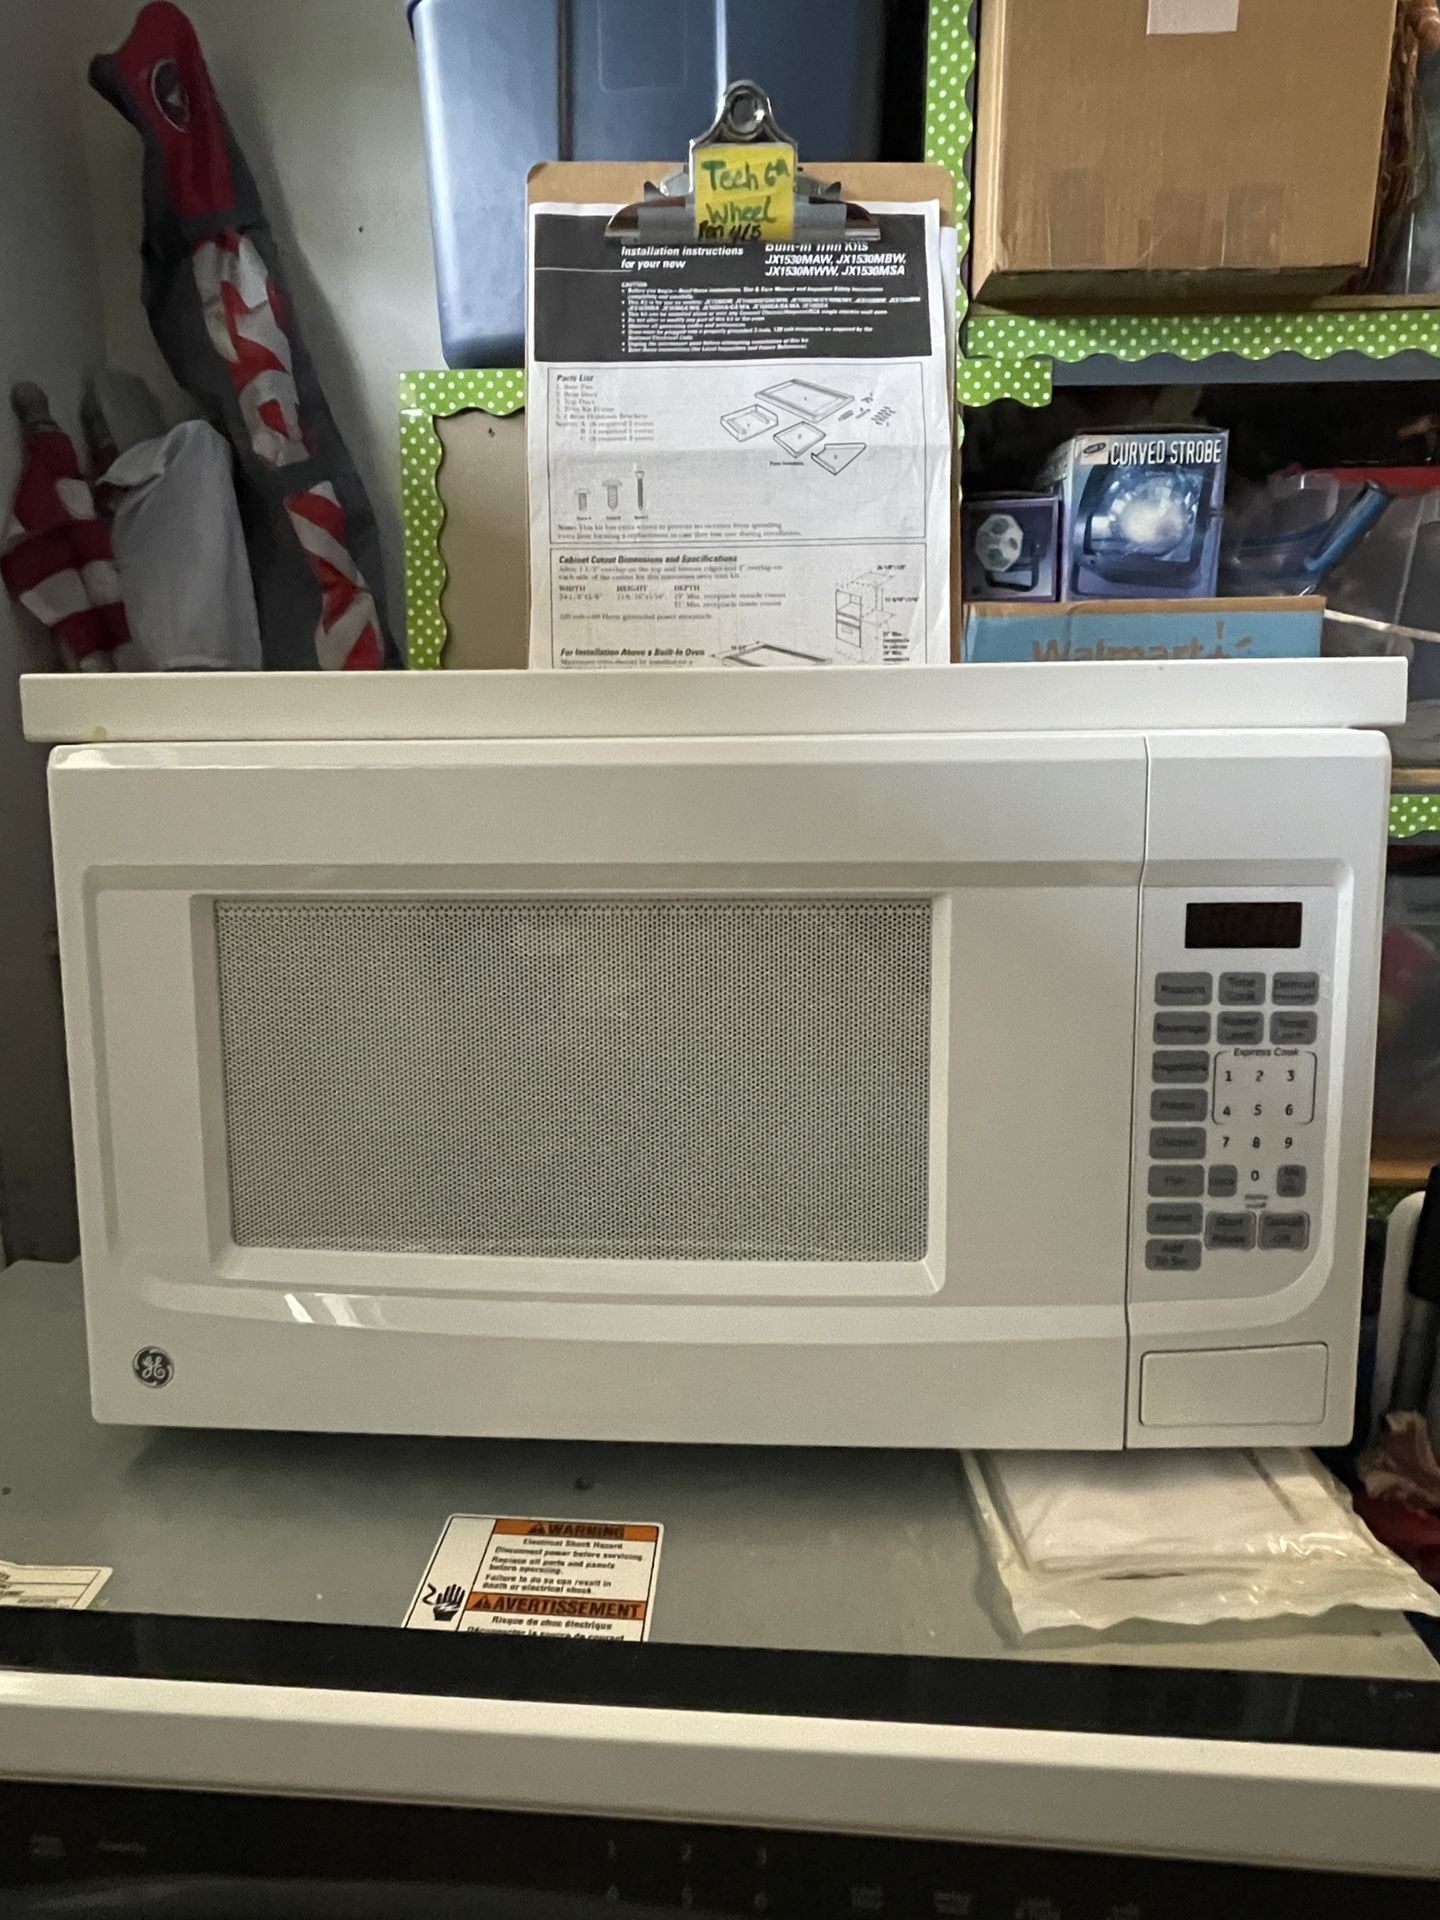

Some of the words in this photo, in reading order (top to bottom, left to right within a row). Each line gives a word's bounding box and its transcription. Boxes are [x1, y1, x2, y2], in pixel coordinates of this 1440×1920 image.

[701, 160, 759, 191] Tech
[705, 195, 777, 224] Wheel
[621, 246, 680, 256] Installation
[682, 246, 744, 256] instructions
[621, 259, 635, 269] for
[637, 259, 661, 271] your
[841, 265, 906, 276] JX1530MSA
[1110, 440, 1165, 465] CURVED
[1170, 439, 1222, 464] STROBE
[561, 648, 574, 656] For
[575, 648, 620, 656] Installation
[621, 648, 646, 656] Above
[685, 648, 705, 656] Oven
[1032, 636, 1204, 660] Walmart
[1233, 1048, 1271, 1057] Express
[1274, 1048, 1300, 1056] Cook
[1225, 1070, 1232, 1082] 1
[1256, 1070, 1264, 1082] 2
[1287, 1070, 1295, 1082] 3
[1222, 1105, 1231, 1117] 4
[1254, 1104, 1262, 1116] 5
[1285, 1103, 1294, 1116] 6
[1222, 1136, 1230, 1148] 7
[1252, 1136, 1261, 1149] 8
[1285, 1136, 1294, 1149] 9
[1250, 1169, 1260, 1182] 0
[549, 1523, 624, 1539] WARNING
[593, 1542, 623, 1550] Hazard
[485, 1574, 517, 1582] Failure
[492, 1596, 642, 1618] AVERTISSEMENT
[492, 1615, 524, 1626] Risque
[526, 1617, 539, 1626] de
